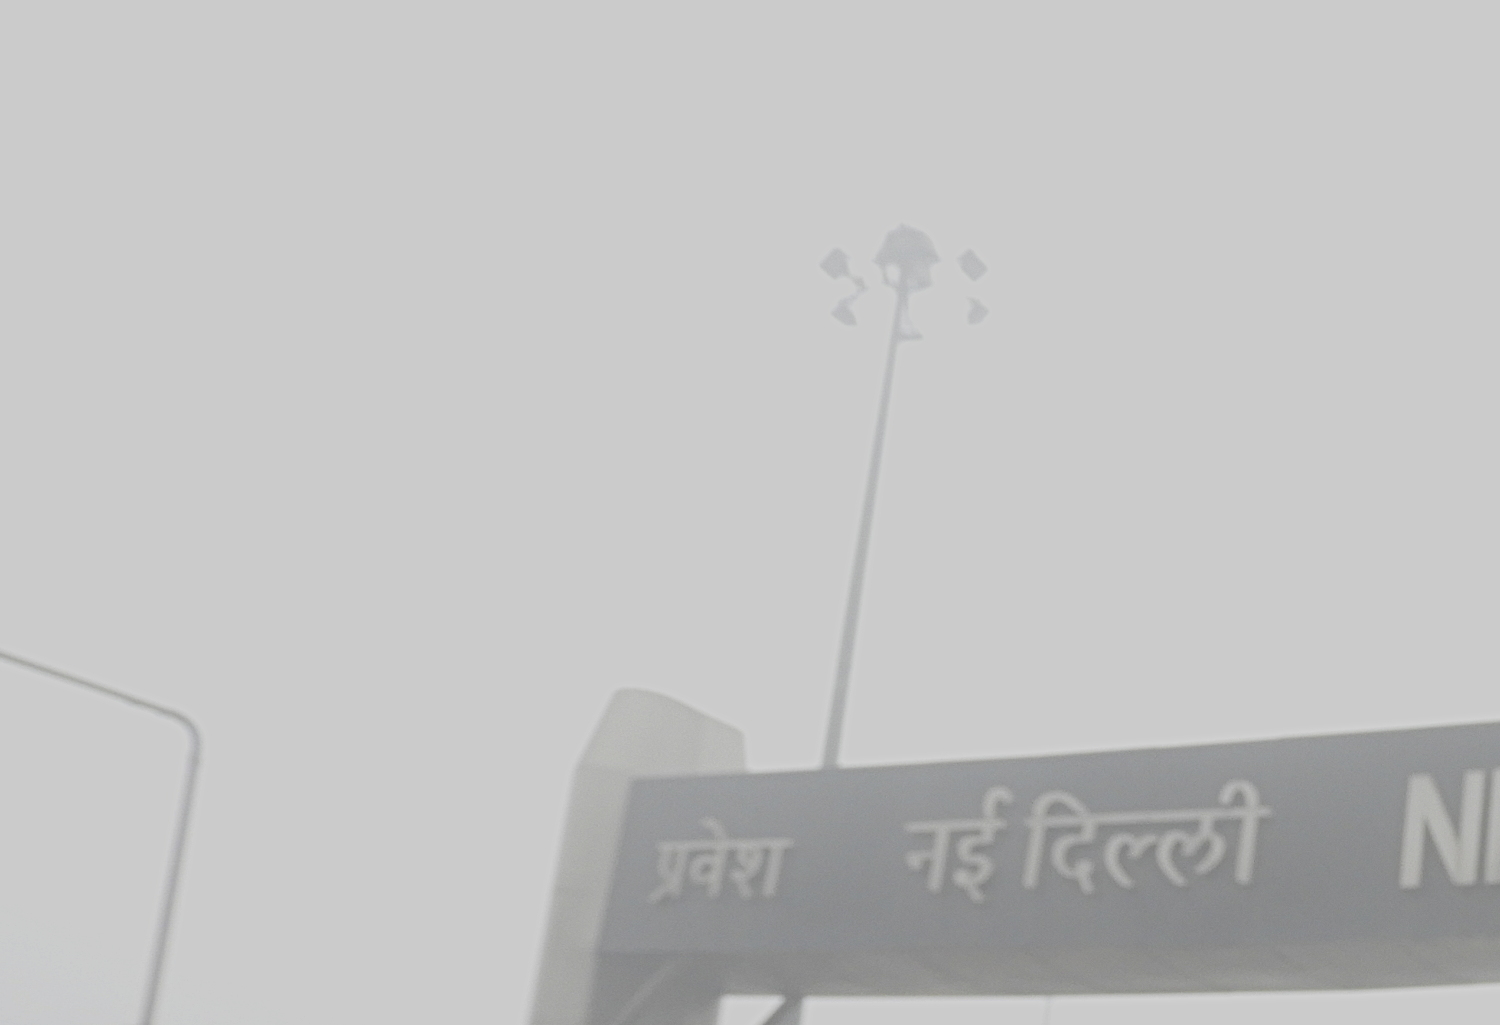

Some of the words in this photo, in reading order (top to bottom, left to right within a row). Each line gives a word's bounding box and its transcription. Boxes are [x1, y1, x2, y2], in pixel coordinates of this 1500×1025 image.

[647, 815, 796, 904] प्रवेश
[904, 784, 1014, 903] नई
[1022, 778, 1273, 895] दिल्ली
